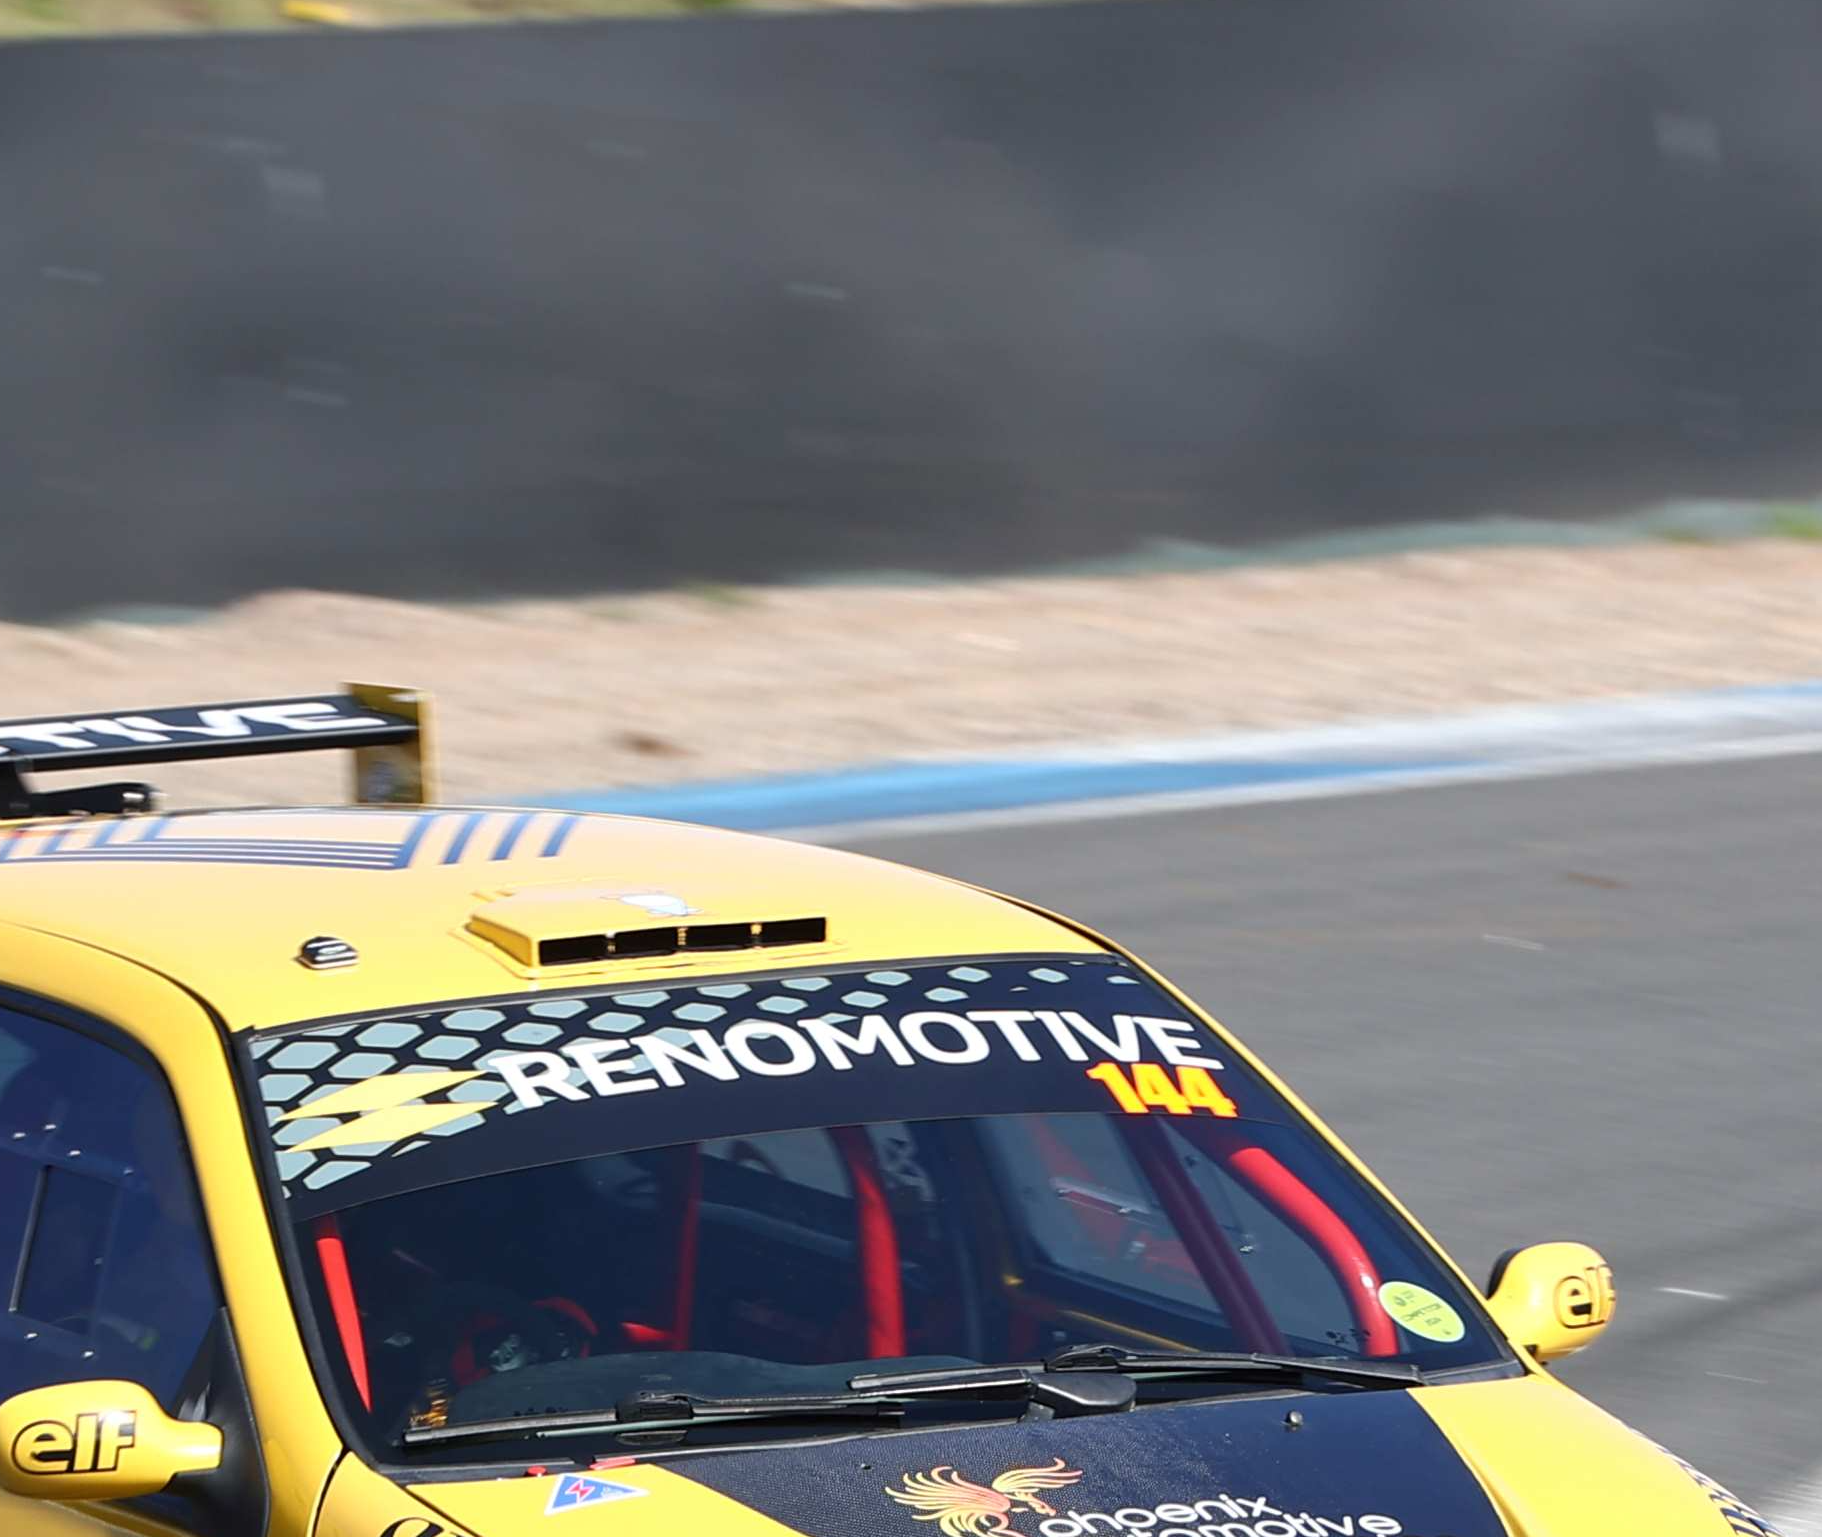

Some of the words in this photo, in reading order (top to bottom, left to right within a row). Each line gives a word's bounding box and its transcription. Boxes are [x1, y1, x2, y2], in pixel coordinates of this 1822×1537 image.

[494, 1010, 1227, 1111] RENOMOTIVE
[1086, 1060, 1240, 1119] 144
[11, 1409, 138, 1476] elf
